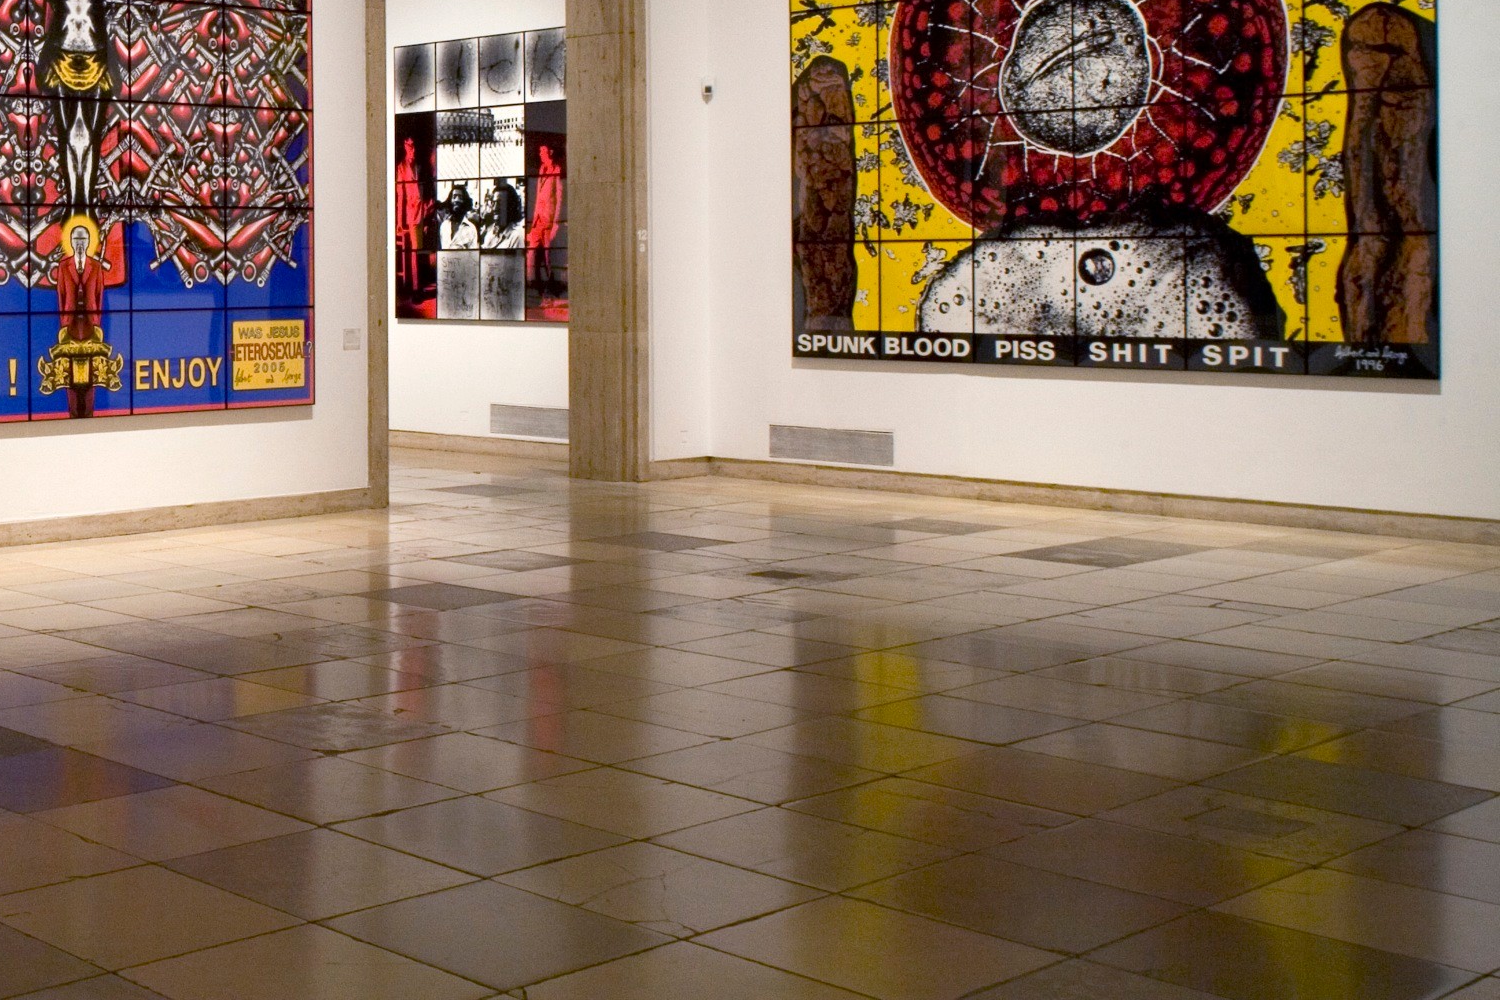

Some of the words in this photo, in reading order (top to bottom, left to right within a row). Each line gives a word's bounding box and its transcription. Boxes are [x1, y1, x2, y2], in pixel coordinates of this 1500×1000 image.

[238, 326, 263, 340] WAS
[266, 325, 300, 339] JESUS
[797, 333, 876, 355] SPUNK
[884, 336, 970, 358] BLOOD
[994, 339, 1056, 362] PISS
[1088, 341, 1173, 365] SHIT
[1201, 344, 1290, 369] SPIT
[135, 356, 224, 391] ENJOY
[1356, 359, 1385, 371] 1996
